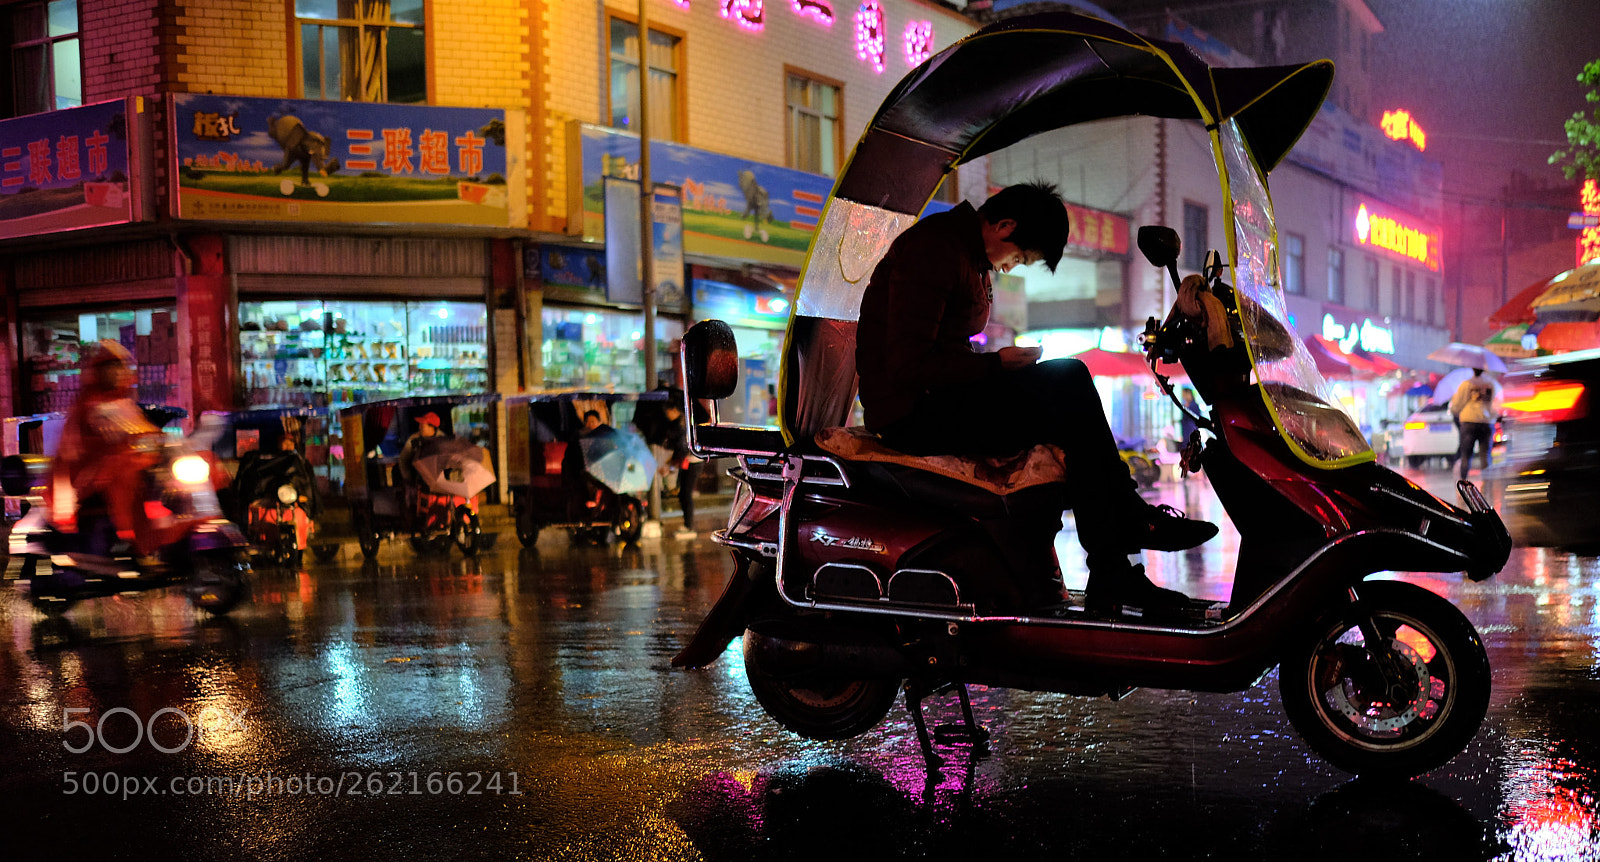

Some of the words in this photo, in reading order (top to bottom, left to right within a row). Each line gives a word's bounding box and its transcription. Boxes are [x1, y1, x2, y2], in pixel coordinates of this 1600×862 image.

[2, 130, 110, 187] 三联超市
[345, 127, 486, 176] 三联超市
